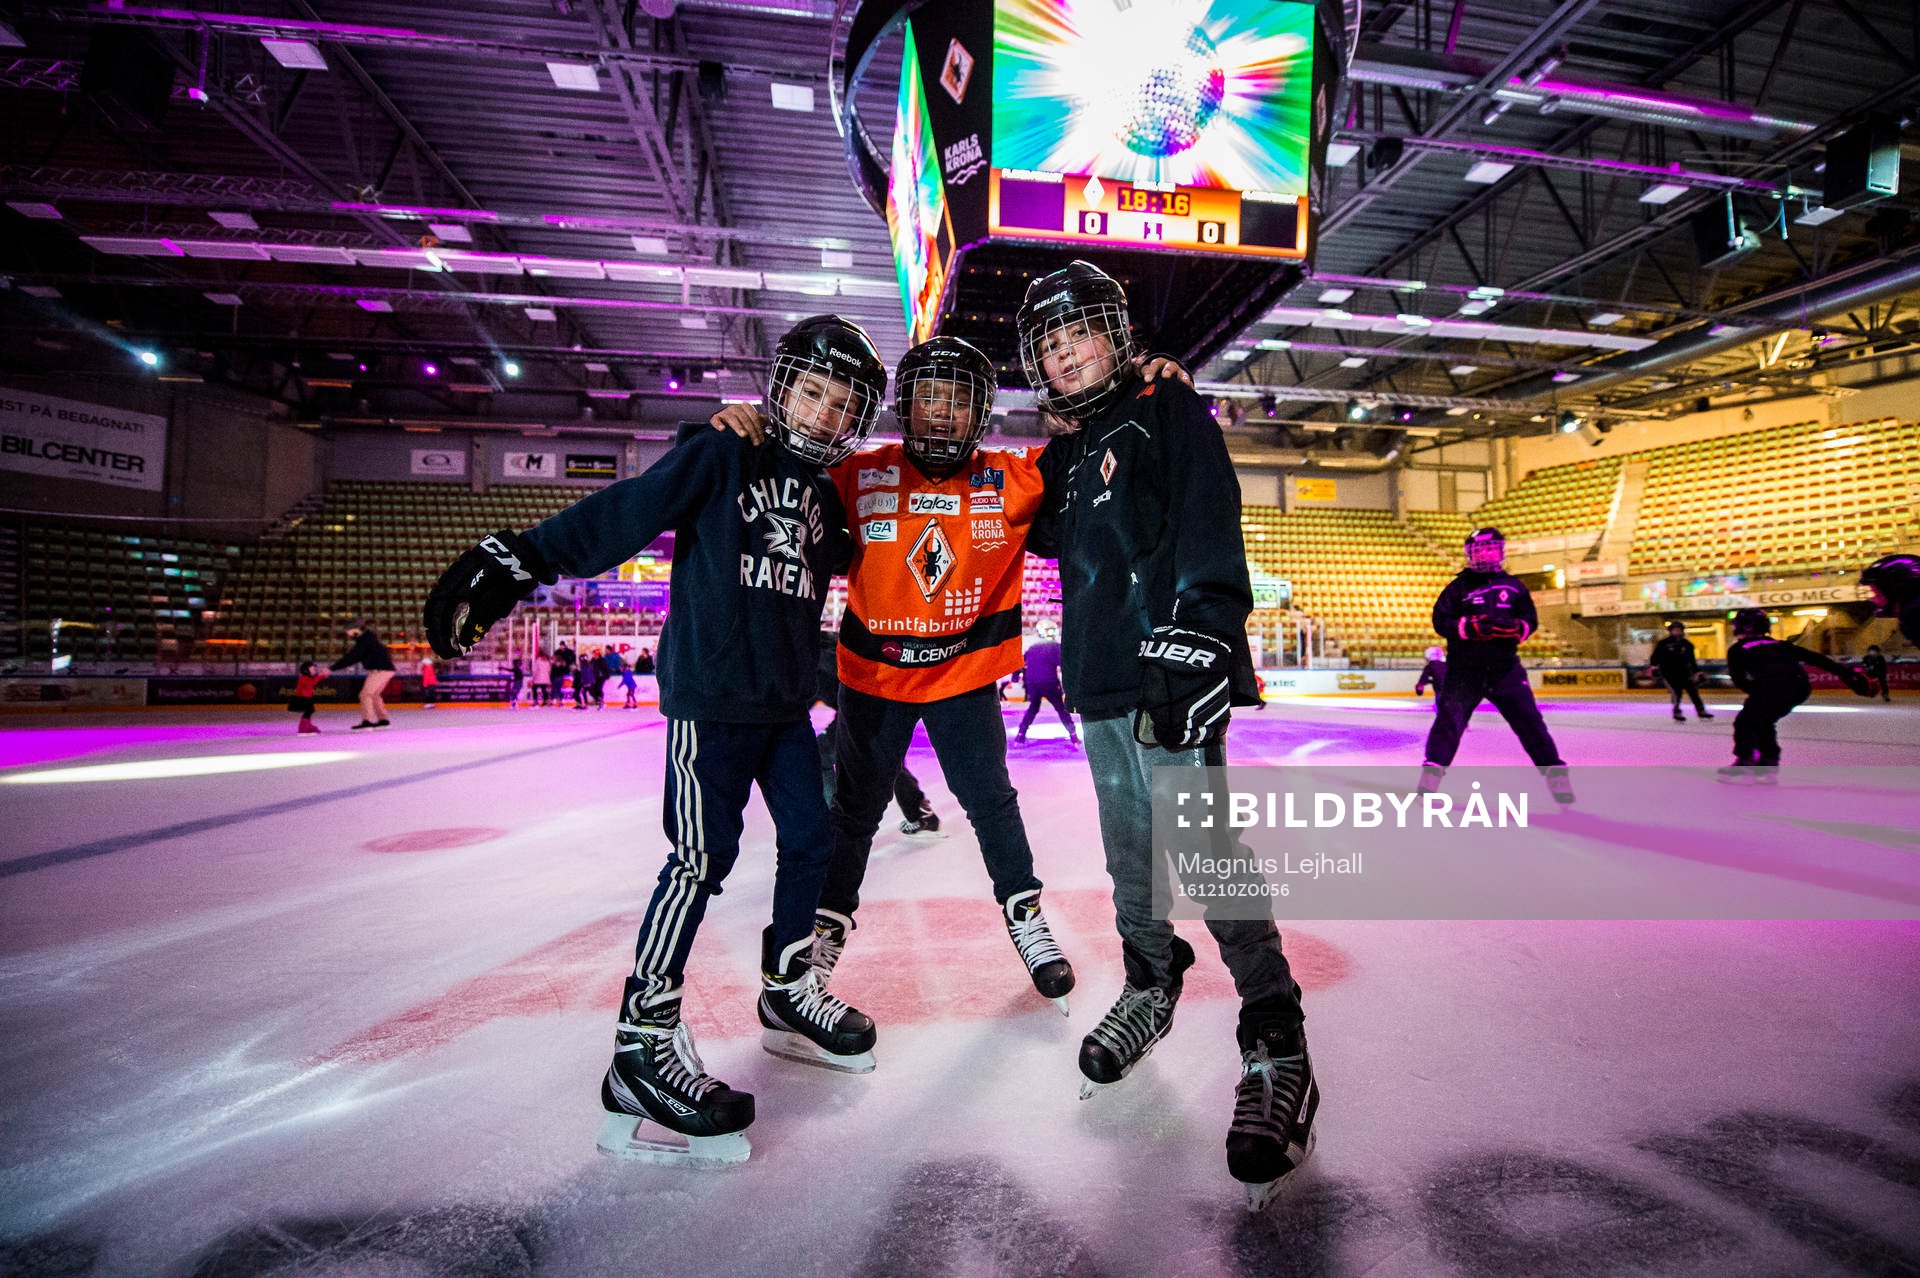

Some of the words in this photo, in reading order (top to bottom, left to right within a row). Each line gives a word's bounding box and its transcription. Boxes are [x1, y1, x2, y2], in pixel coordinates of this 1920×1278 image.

[945, 133, 978, 160] KARLS
[945, 145, 983, 173] KRONA
[1120, 188, 1190, 215] 18:16
[1084, 212, 1101, 234] 0
[1203, 222, 1219, 243] 0
[1033, 290, 1069, 311] BAUER
[829, 347, 862, 368] Reebok
[930, 350, 961, 358] CCM
[1, 434, 146, 473] BILCENTER
[737, 477, 824, 545] CHICAGO
[915, 496, 954, 512] jalas
[971, 520, 1002, 530] KARLS
[971, 529, 1005, 540] KRONA
[480, 534, 533, 582] CM
[900, 638, 968, 663] BILCENTER
[653, 1005, 679, 1018] CCM
[667, 1099, 688, 1113] CCM
